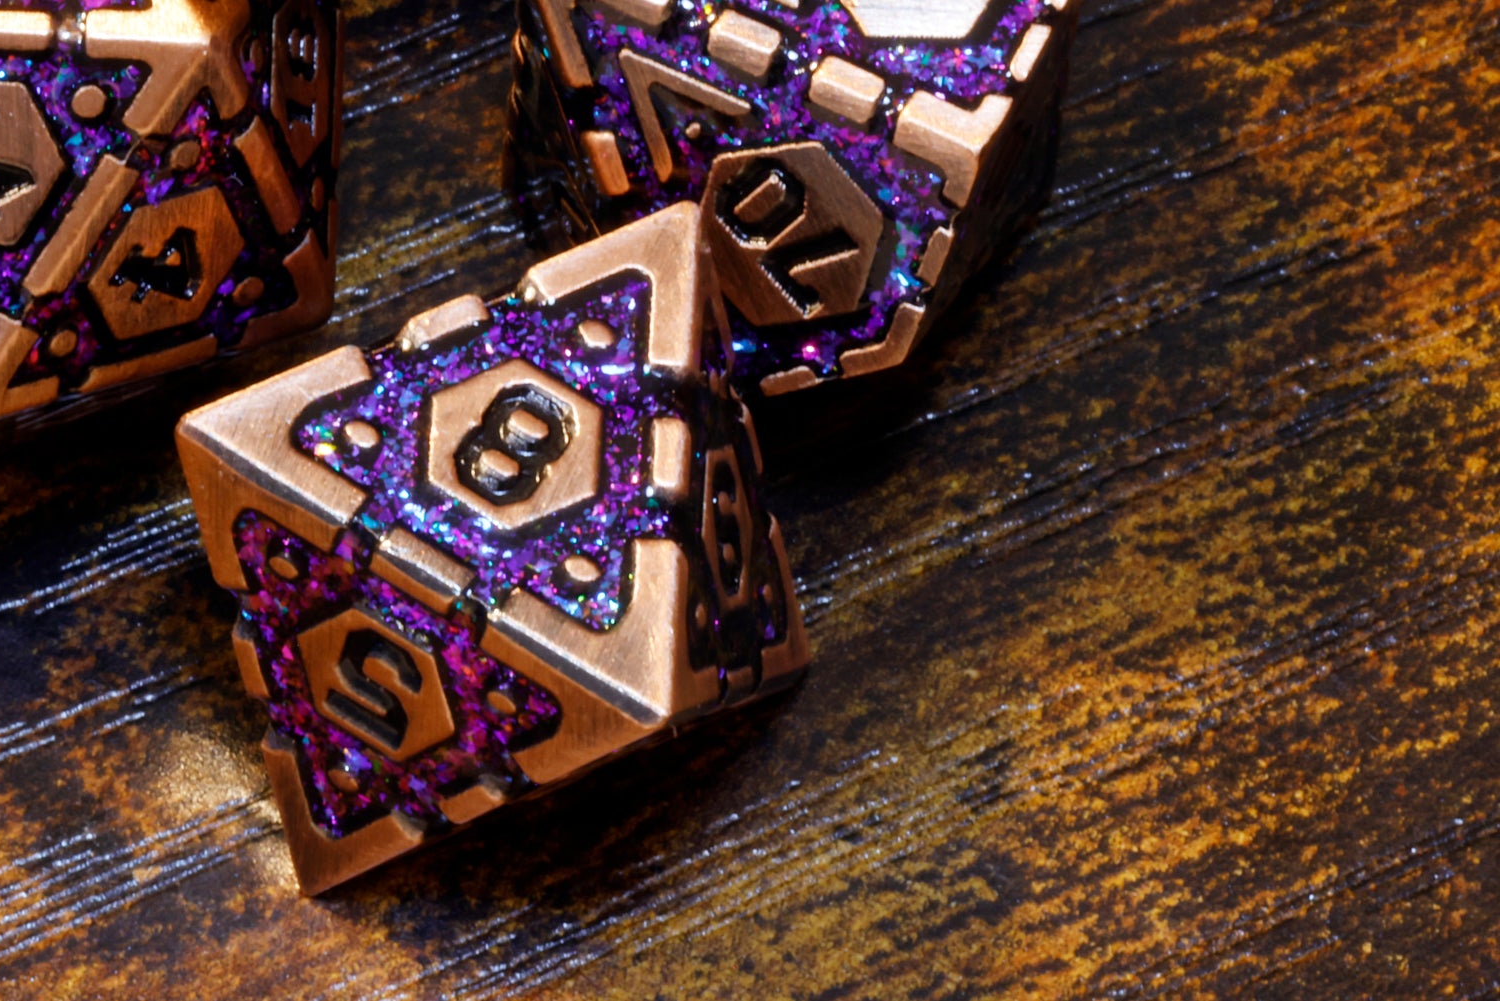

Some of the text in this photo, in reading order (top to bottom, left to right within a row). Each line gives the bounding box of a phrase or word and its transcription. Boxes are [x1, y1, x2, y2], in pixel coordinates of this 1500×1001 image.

[108, 227, 203, 303] 4
[714, 157, 860, 319] 70
[455, 383, 580, 506] 8
